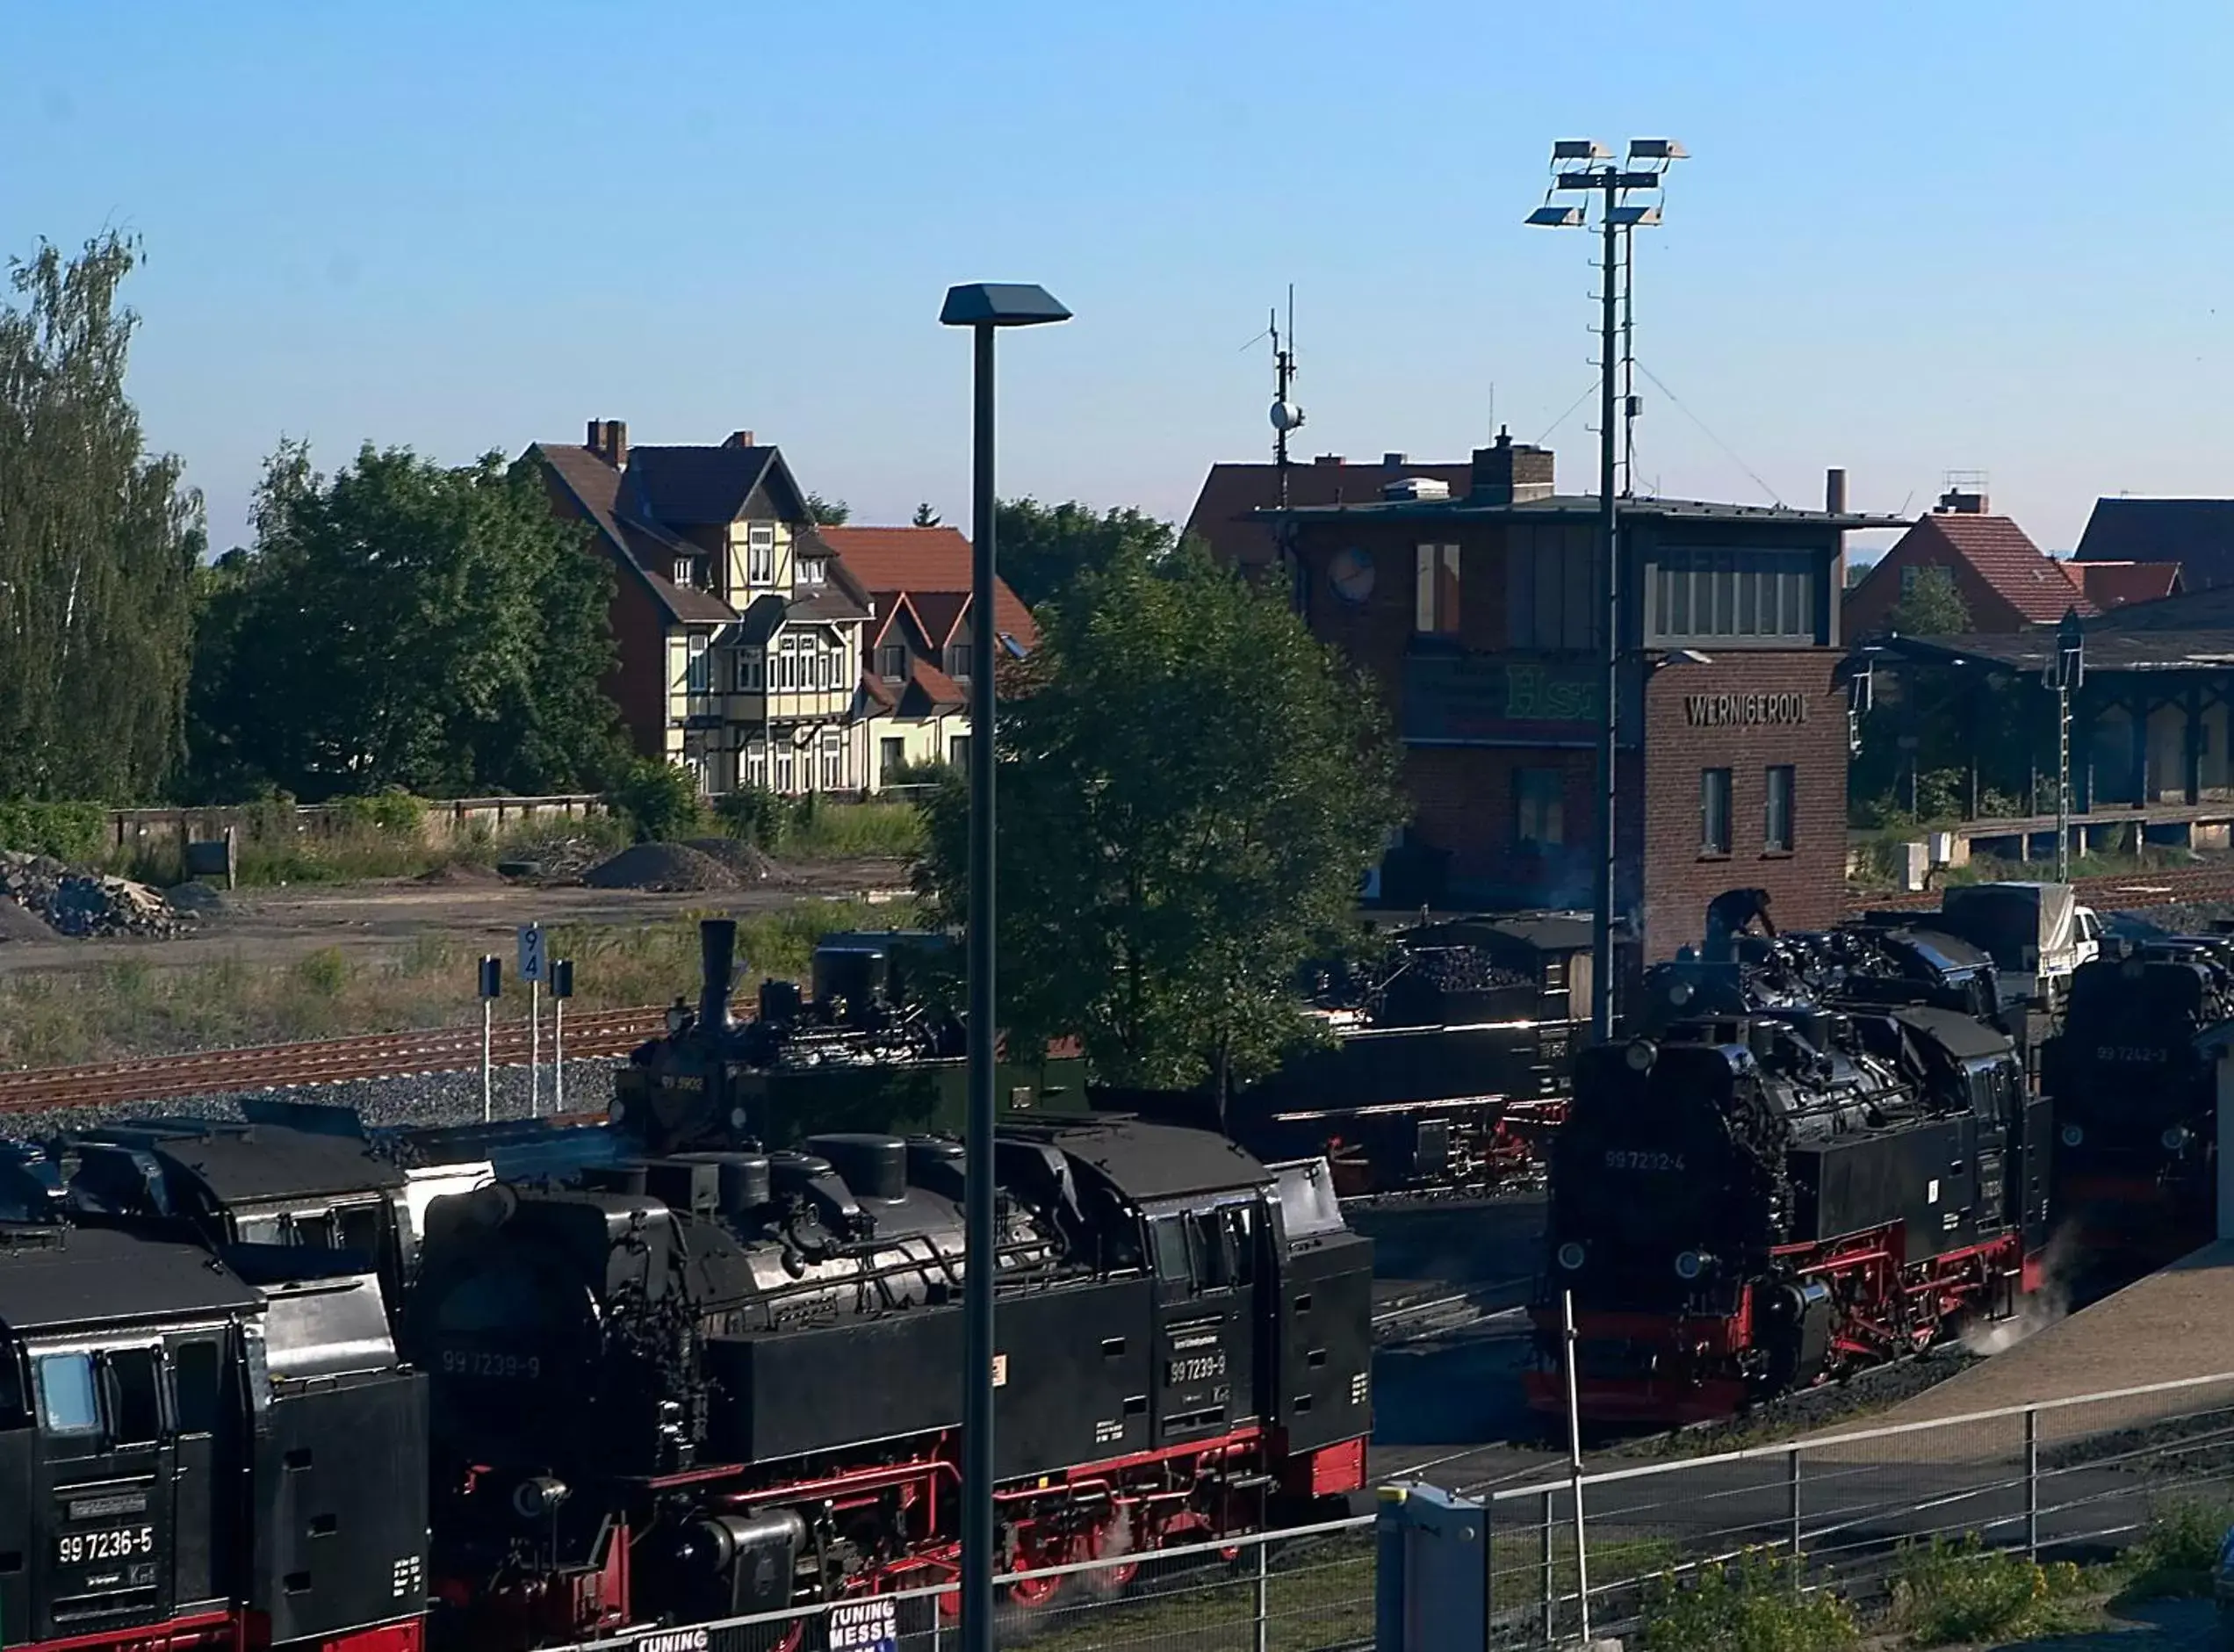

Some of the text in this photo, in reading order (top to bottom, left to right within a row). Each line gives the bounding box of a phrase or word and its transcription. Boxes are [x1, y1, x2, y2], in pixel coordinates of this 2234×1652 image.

[525, 930, 537, 951] 9
[525, 954, 537, 976] 4
[59, 1526, 153, 1562] 99 7236-5
[830, 1600, 895, 1629] TUNING
[829, 1619, 897, 1651] MESSE
